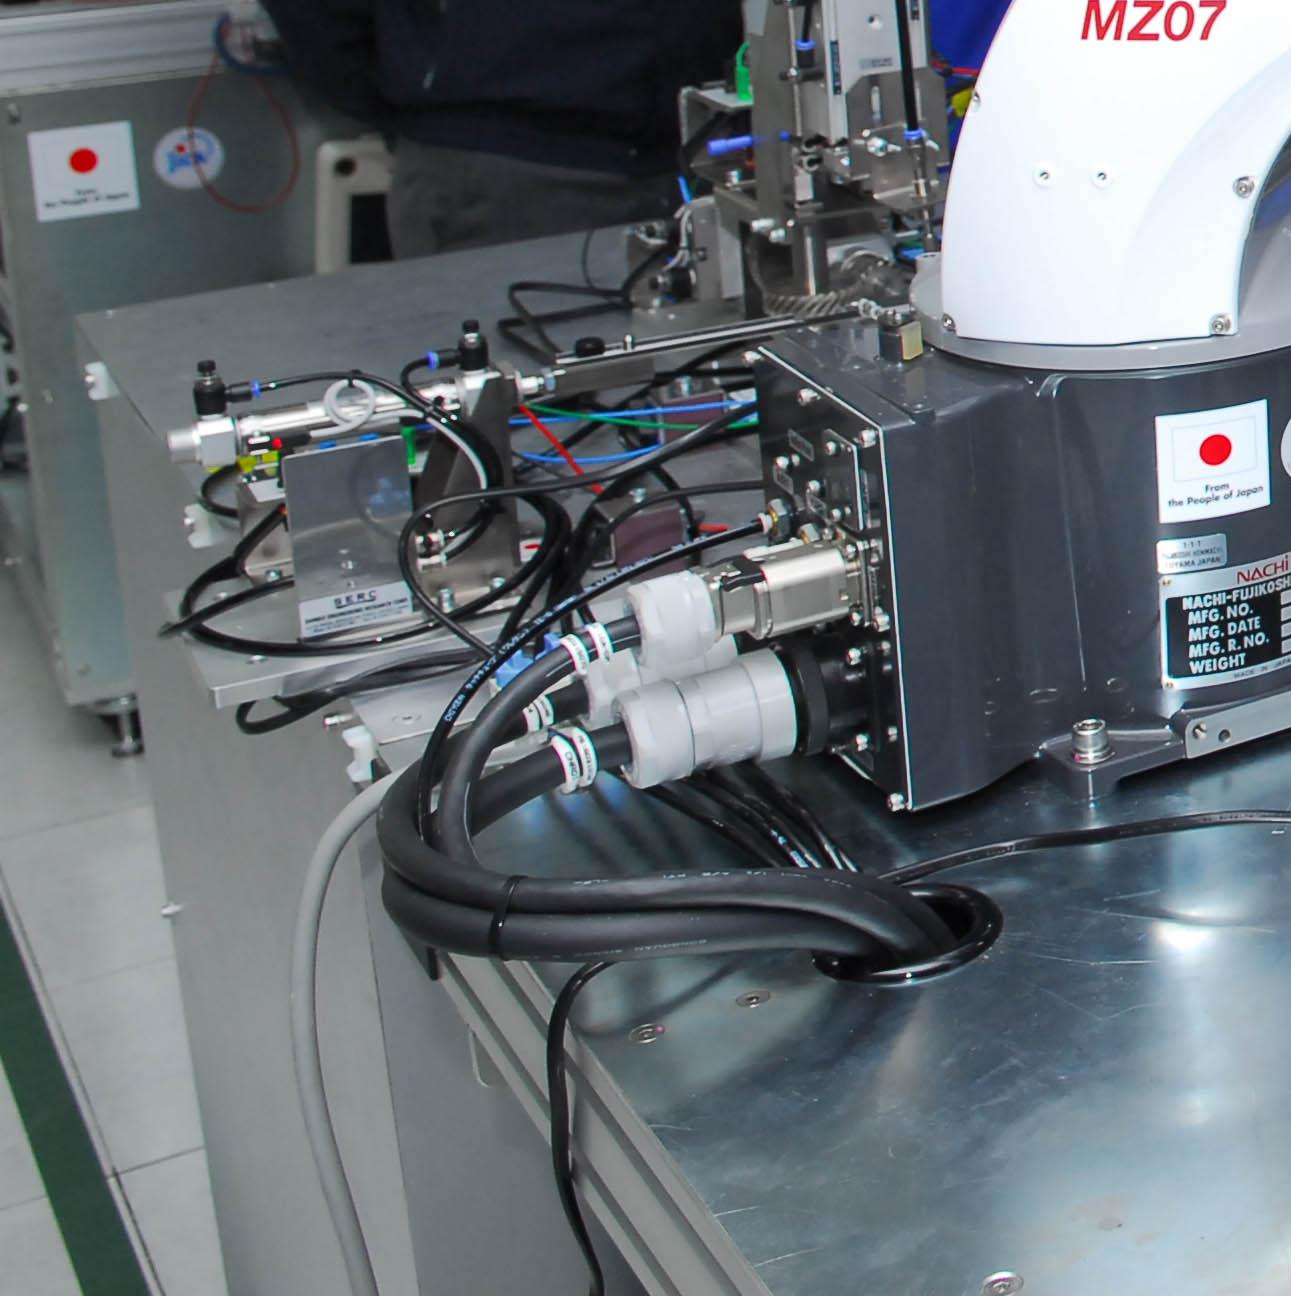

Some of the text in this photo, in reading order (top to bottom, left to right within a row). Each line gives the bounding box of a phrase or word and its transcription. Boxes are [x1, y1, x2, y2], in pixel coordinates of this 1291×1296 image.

[1168, 484, 1264, 507] the People of Japan
[1205, 482, 1230, 493] From
[1188, 603, 1253, 625] MFG. NO.
[1188, 616, 1261, 642] MFG. DATE
[1188, 632, 1270, 659] MFG. R. NO.
[1189, 653, 1246, 674] WEIGHT
